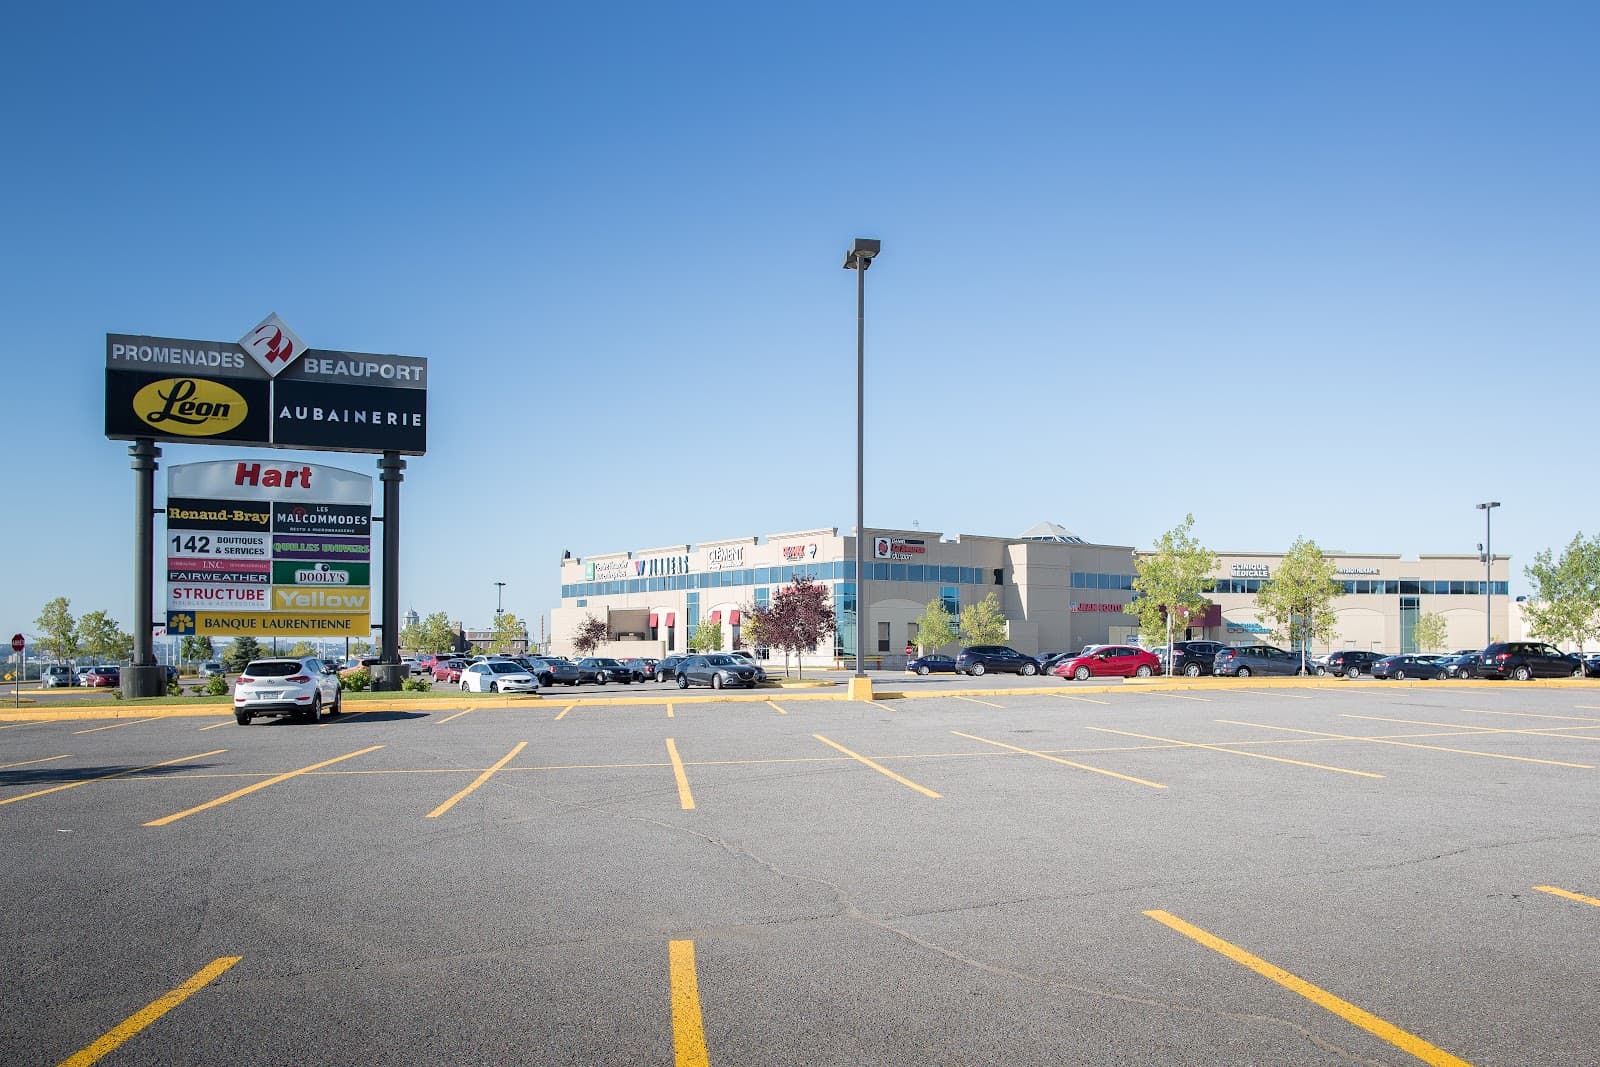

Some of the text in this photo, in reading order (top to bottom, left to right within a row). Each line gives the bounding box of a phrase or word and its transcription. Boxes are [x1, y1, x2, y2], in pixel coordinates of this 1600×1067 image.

[112, 344, 424, 381] PROMENADES BEAUPORT
[147, 380, 230, 424] Léon
[279, 406, 422, 427] AUBAINERIE
[235, 462, 313, 488] Hart
[169, 508, 270, 524] Renaud-Bray
[277, 513, 368, 525] MALCOMMODES
[172, 535, 210, 553] 142
[217, 536, 263, 545] BOUTIQUES
[225, 547, 265, 555] SERVICES
[170, 572, 268, 582] FAIRWEATHER
[300, 572, 346, 583] DOOLY'S
[173, 587, 265, 600] STRUCTUBE
[277, 590, 366, 608] Yellow
[205, 618, 352, 630] BANQUE LAURENTIENNE
